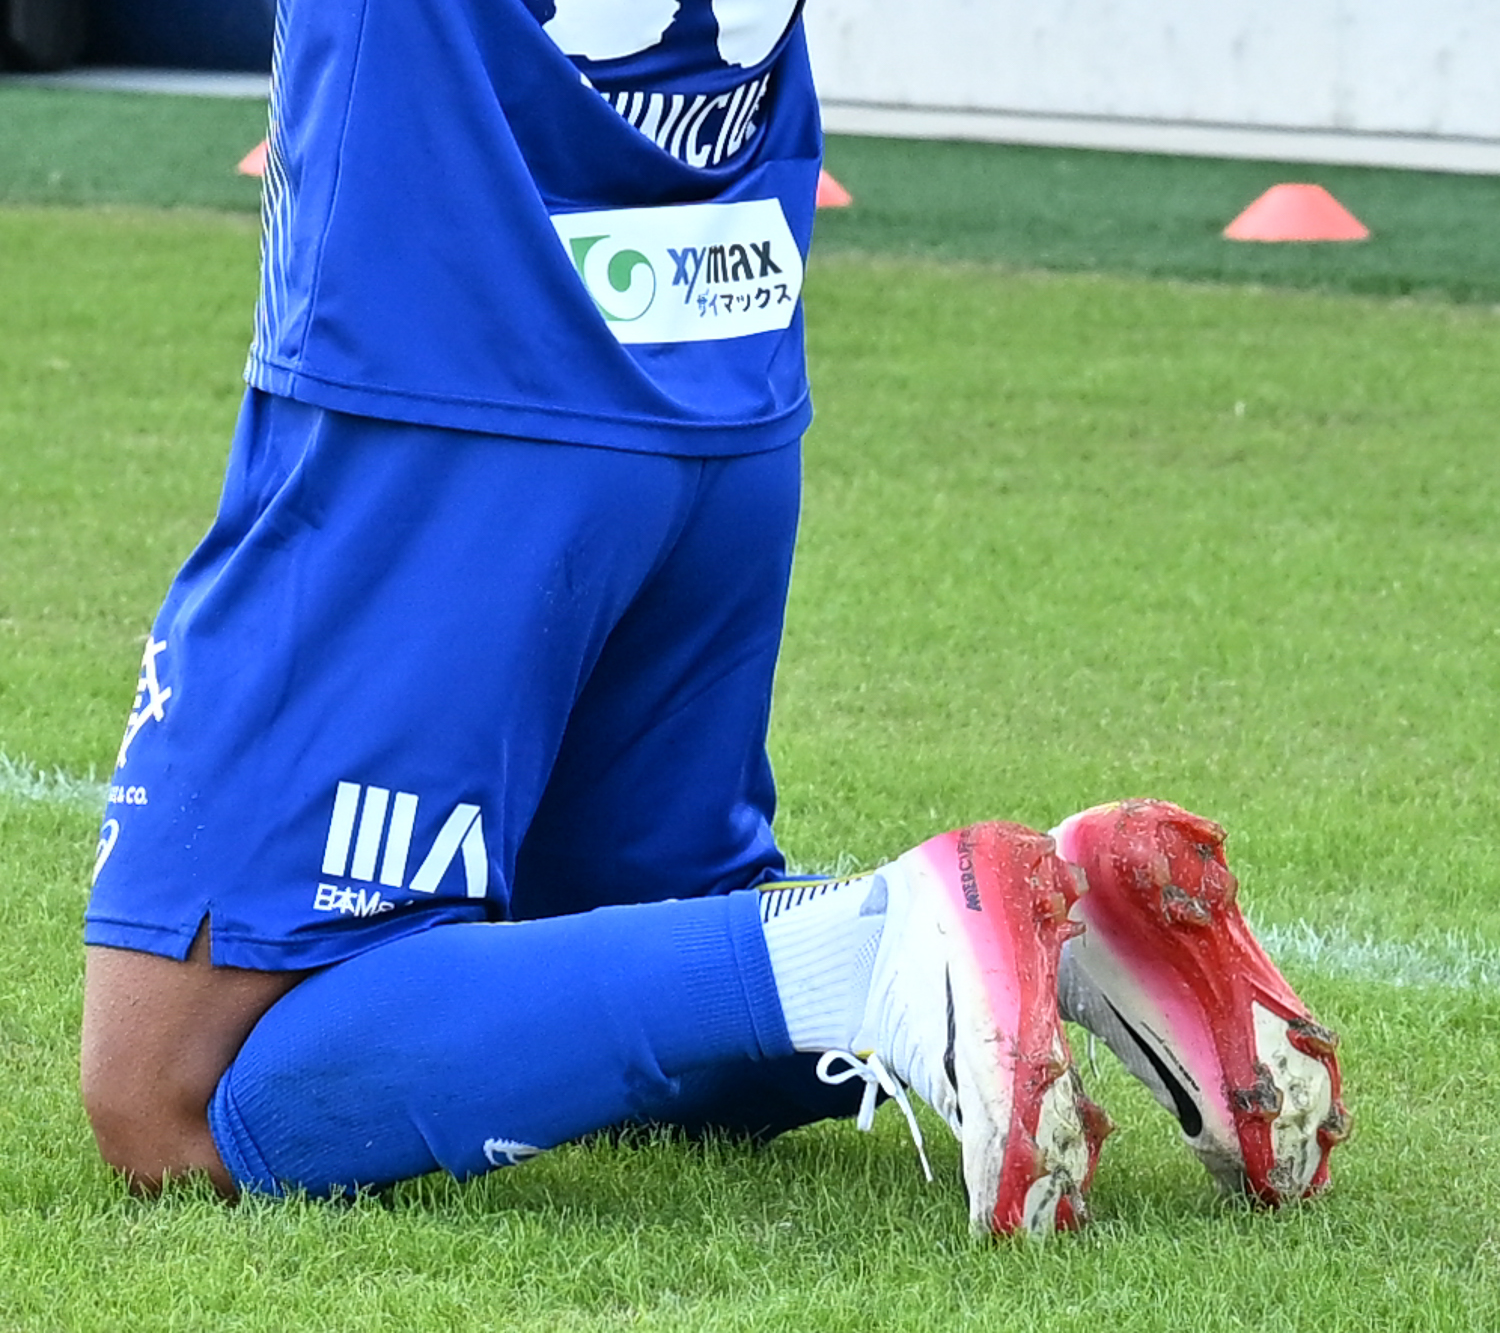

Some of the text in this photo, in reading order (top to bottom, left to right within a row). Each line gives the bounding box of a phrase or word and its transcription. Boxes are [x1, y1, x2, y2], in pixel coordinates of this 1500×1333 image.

[666, 240, 783, 305] xymax
[697, 283, 792, 318] ザイマックス
